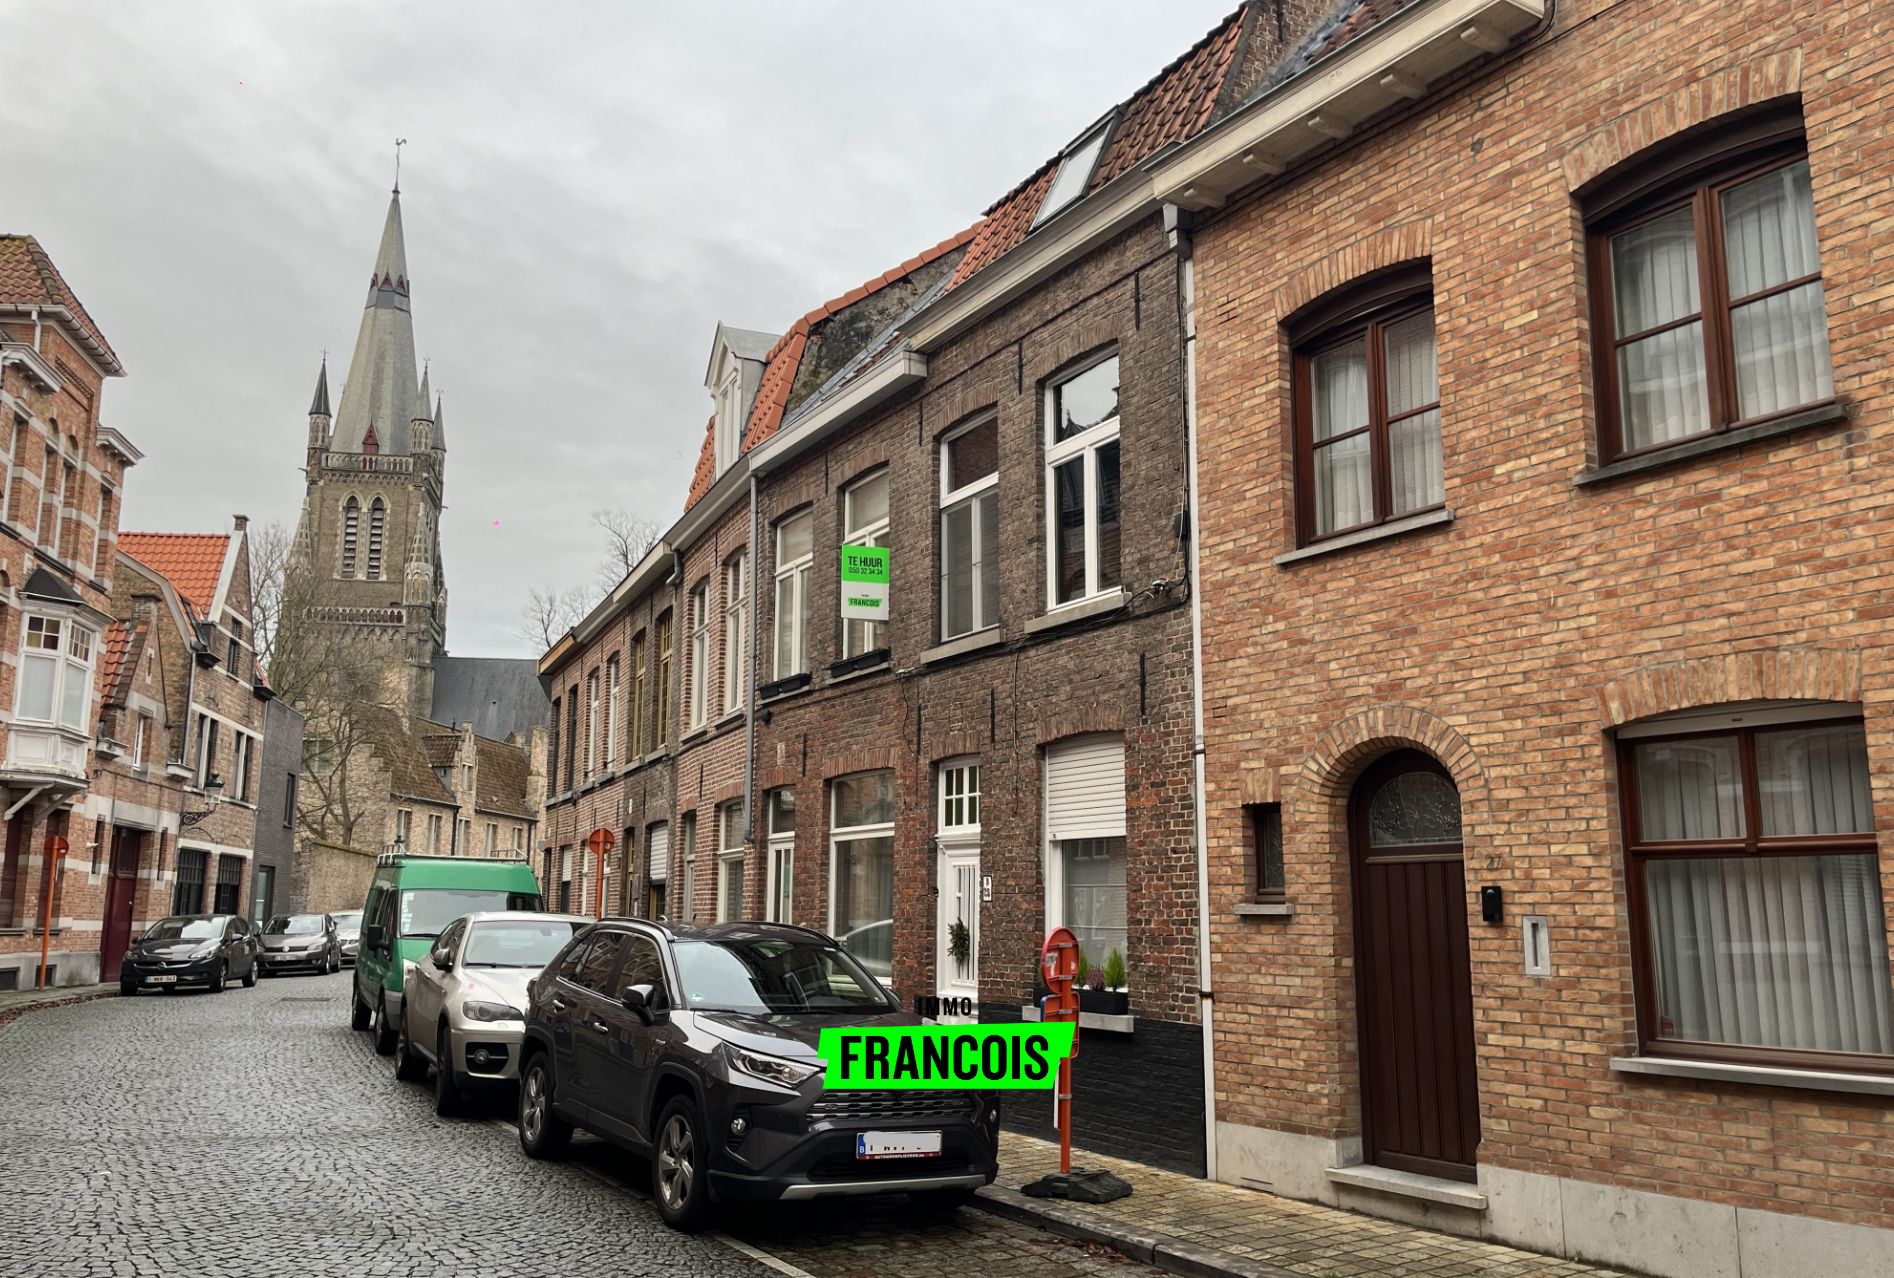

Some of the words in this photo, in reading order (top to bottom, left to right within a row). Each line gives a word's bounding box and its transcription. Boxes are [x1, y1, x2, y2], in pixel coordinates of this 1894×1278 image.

[848, 556, 858, 566] TE
[860, 556, 882, 568] HUUR
[850, 598, 880, 607] FRANCOIS
